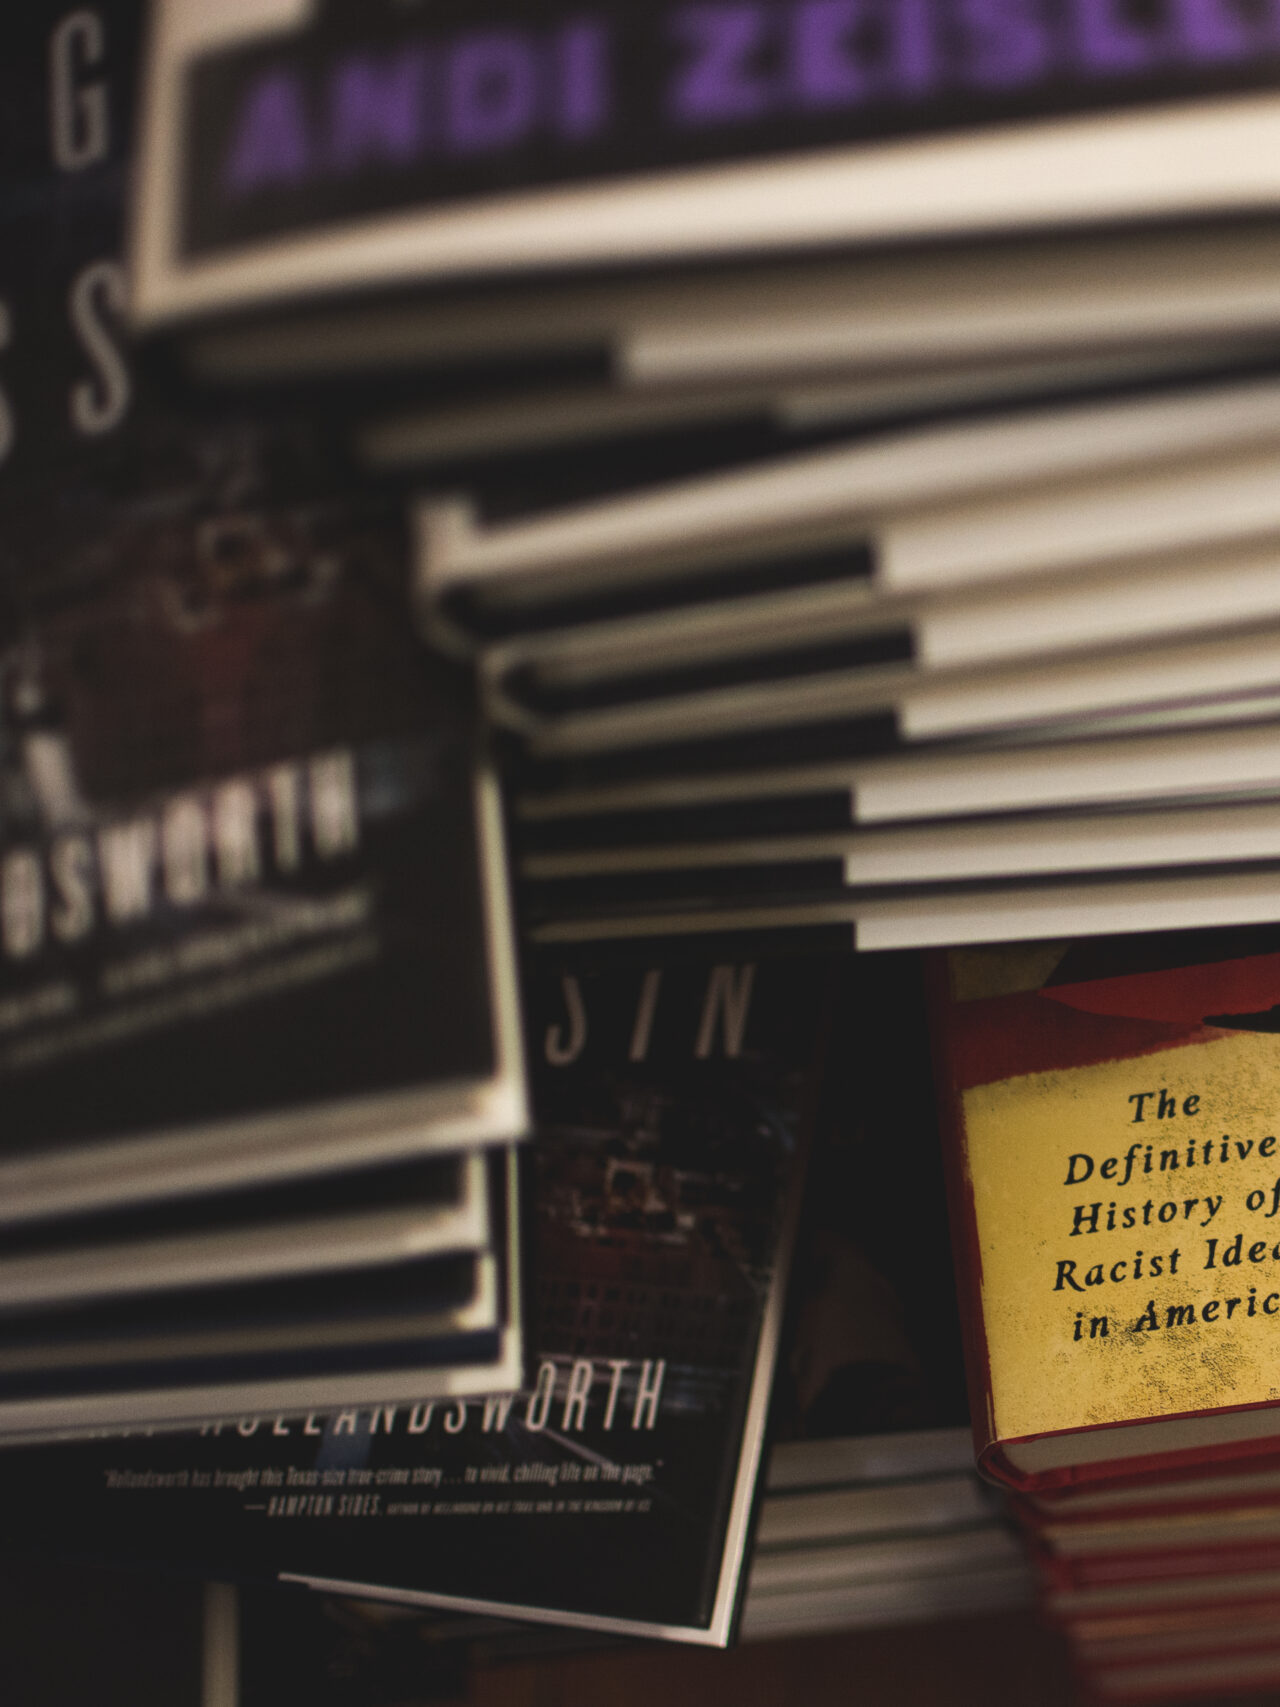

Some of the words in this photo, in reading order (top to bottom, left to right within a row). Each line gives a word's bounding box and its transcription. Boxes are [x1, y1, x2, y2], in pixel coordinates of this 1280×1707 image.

[225, 18, 608, 190] ANDI
[1128, 1088, 1201, 1123] The
[1063, 1135, 1277, 1186] Definitive
[1069, 1195, 1222, 1236] History
[1052, 1248, 1181, 1292] Racist
[1073, 1311, 1109, 1341] in
